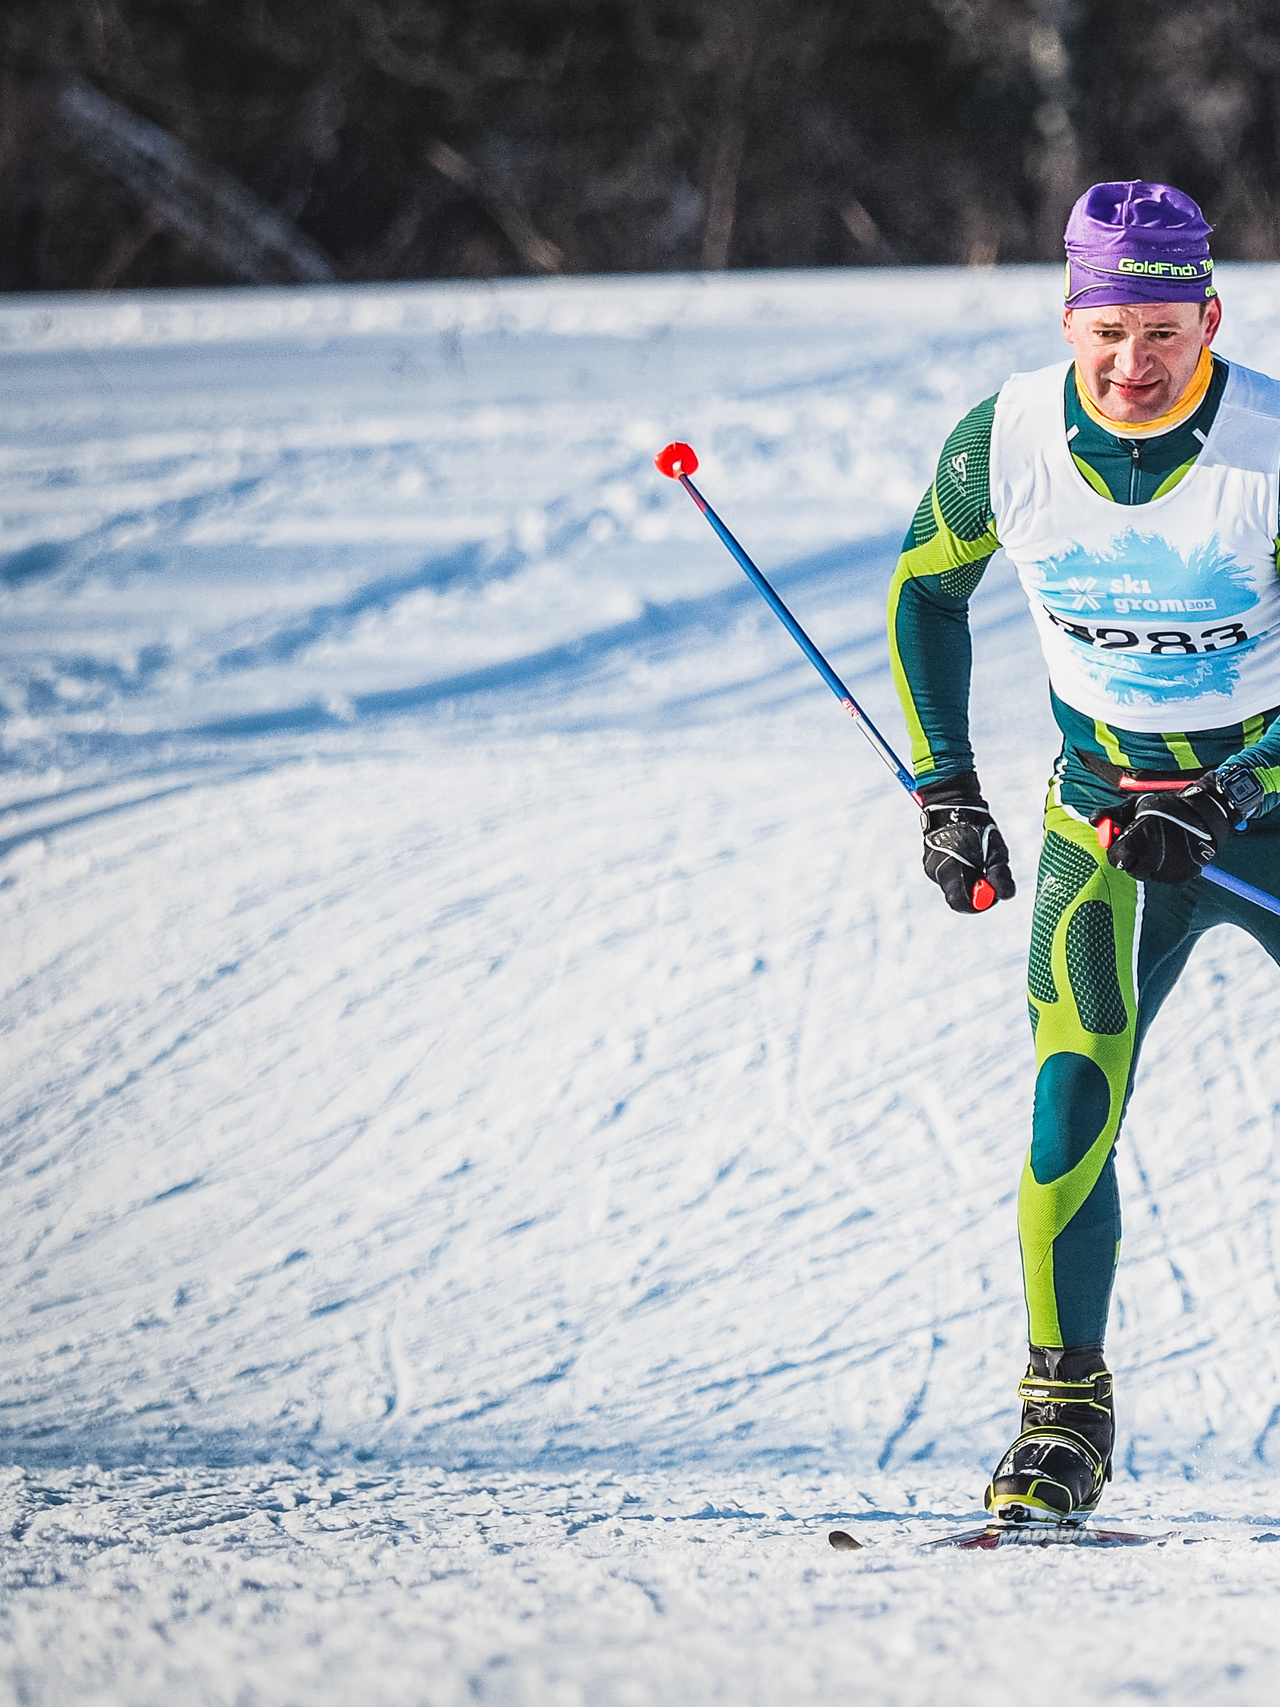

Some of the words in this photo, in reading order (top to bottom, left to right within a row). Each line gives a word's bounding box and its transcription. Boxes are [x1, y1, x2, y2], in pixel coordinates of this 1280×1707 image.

[1118, 257, 1198, 276] GoldFinch
[1110, 574, 1151, 594] ski
[1113, 597, 1186, 614] grom
[1188, 600, 1215, 611] 30K
